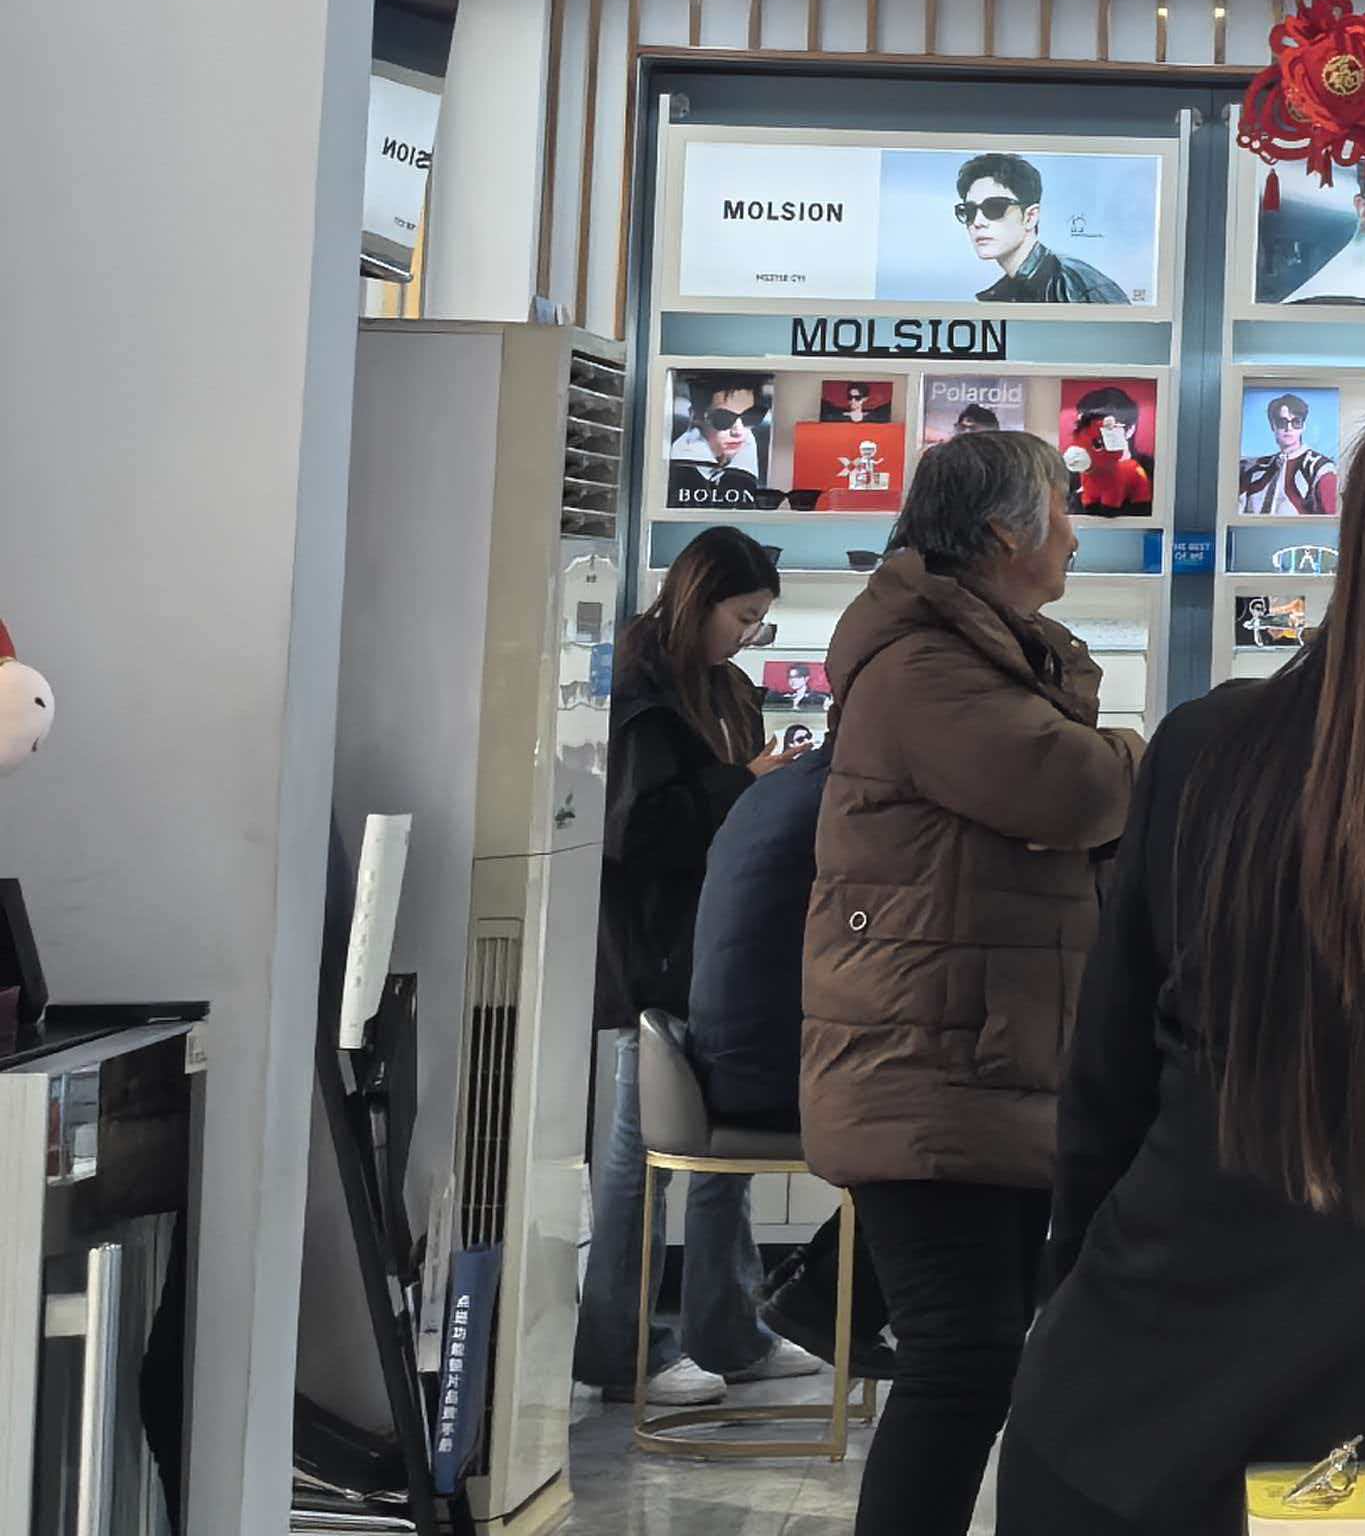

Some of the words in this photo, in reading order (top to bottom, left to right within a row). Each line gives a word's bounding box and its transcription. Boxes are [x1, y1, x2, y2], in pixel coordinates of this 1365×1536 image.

[723, 199, 843, 223] MOLSION
[791, 317, 1007, 360] MOLSION
[932, 381, 1022, 402] Polaroid
[679, 488, 755, 502] BOLON
